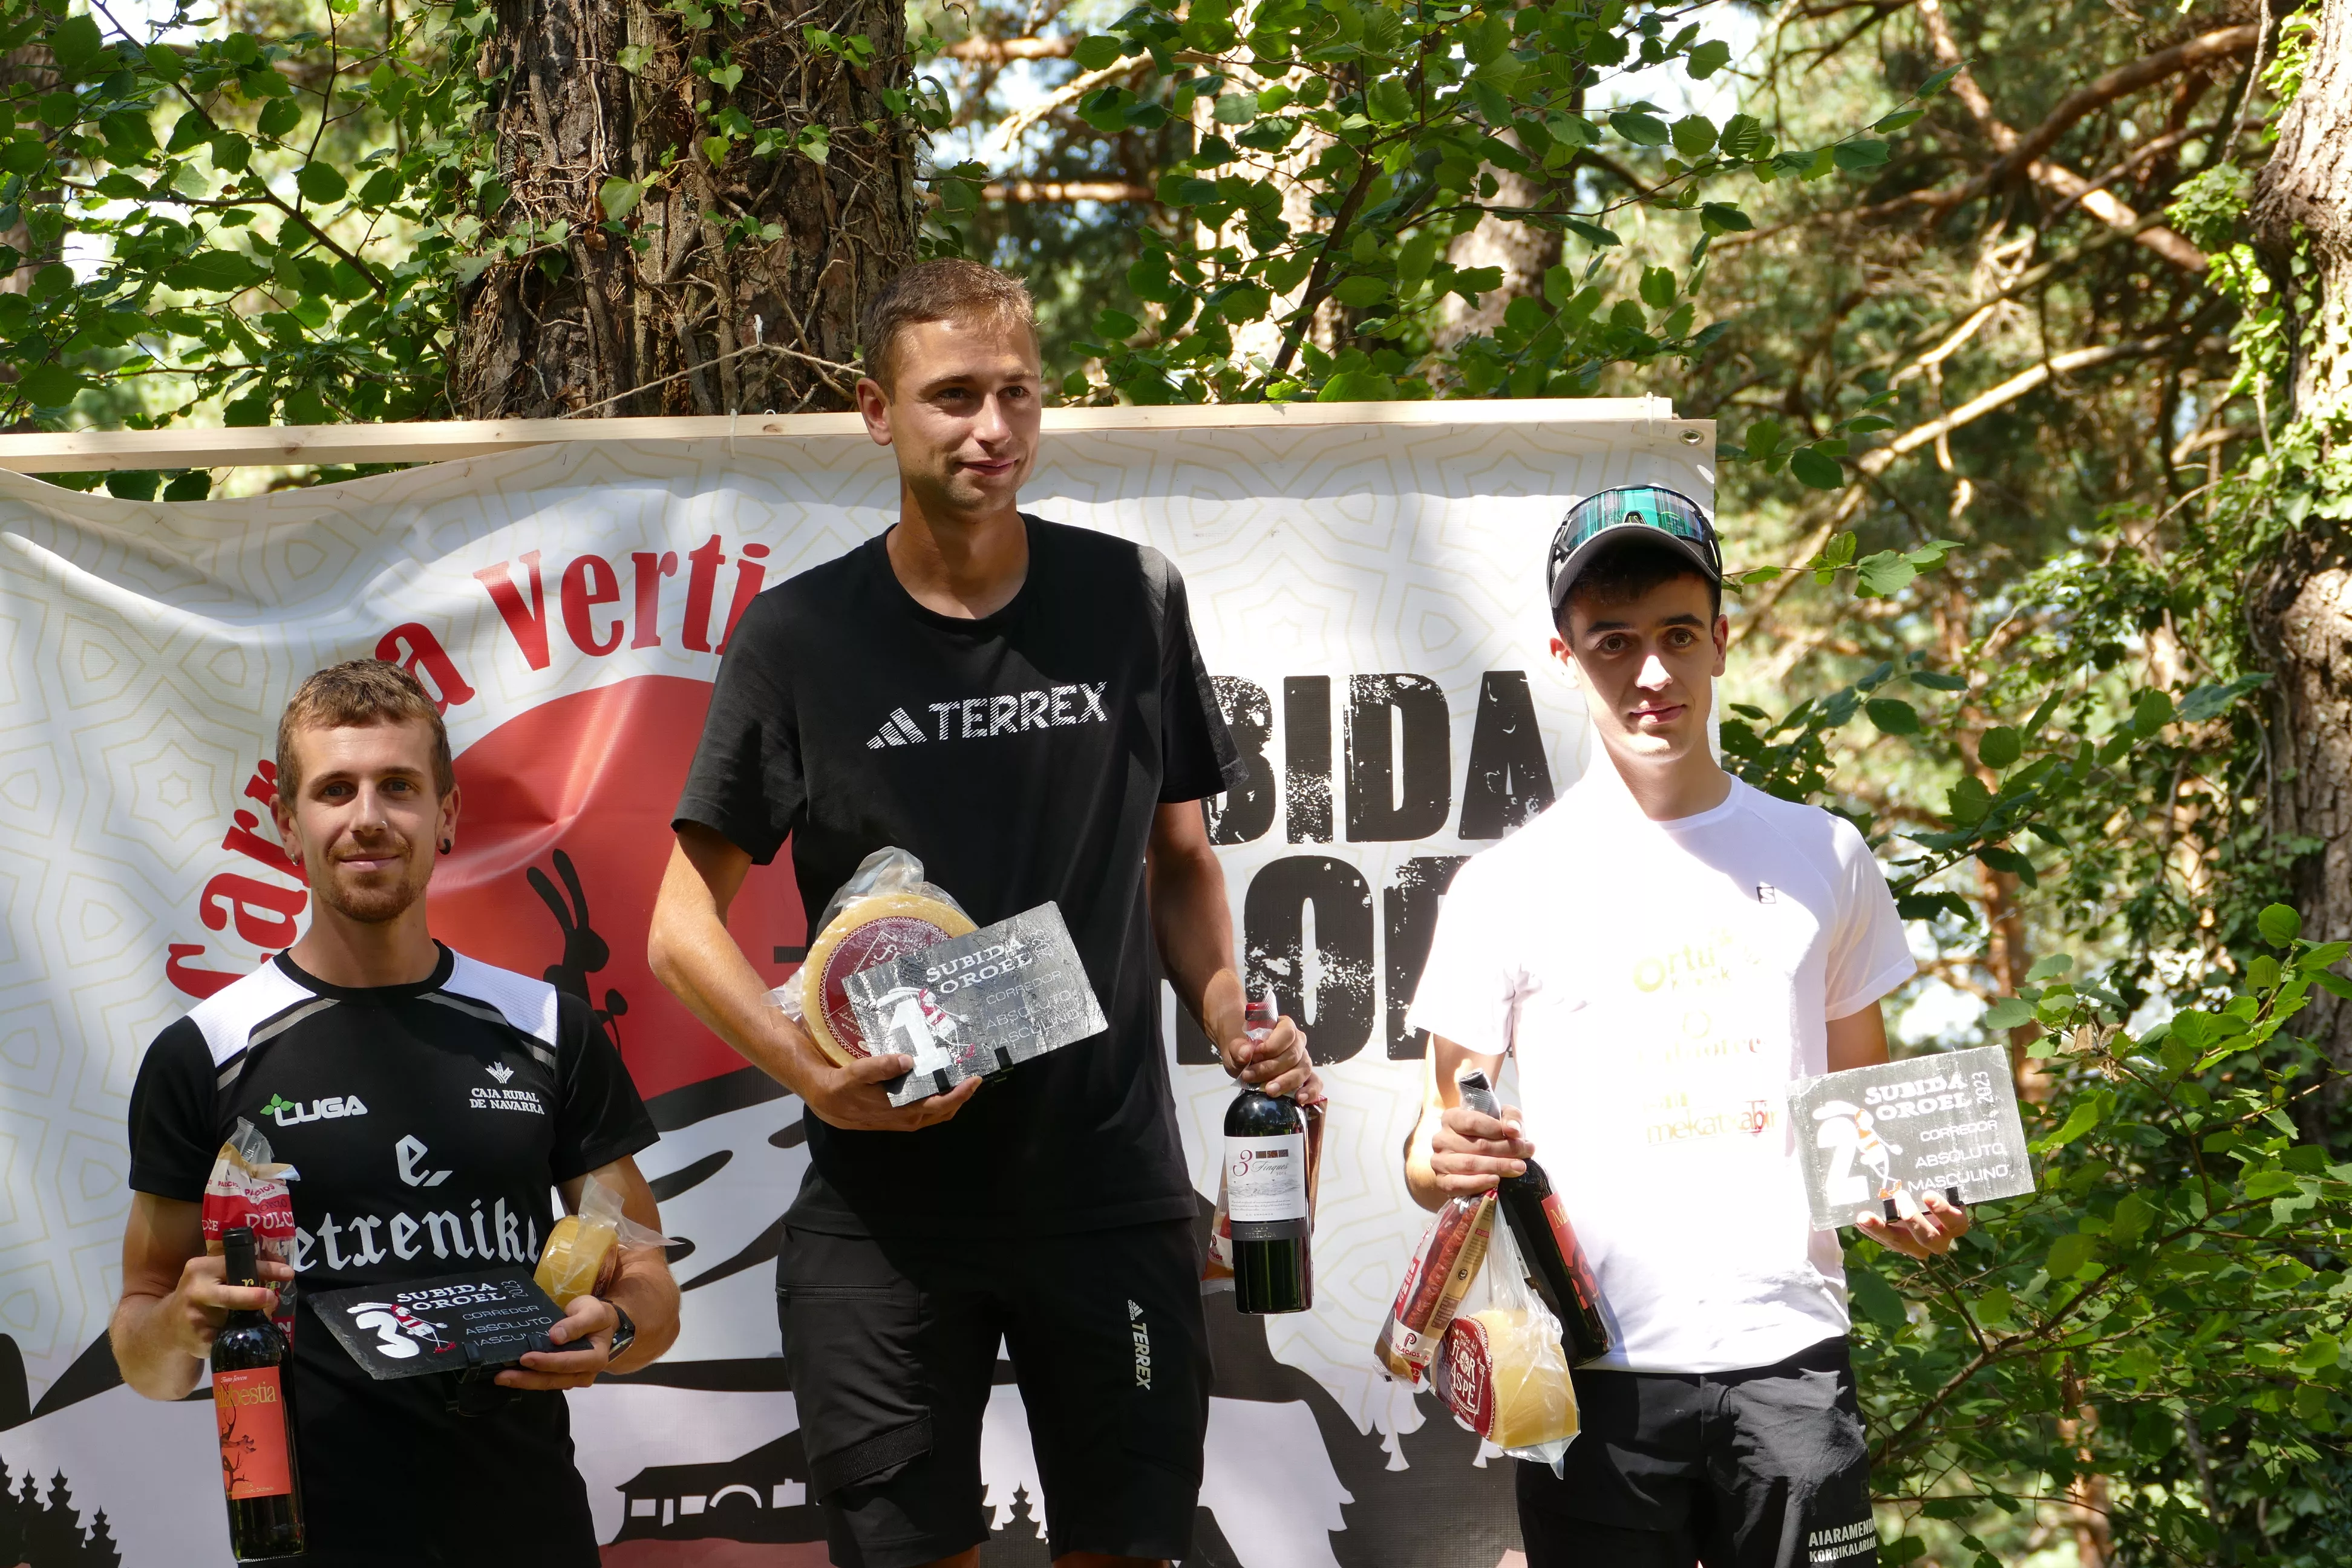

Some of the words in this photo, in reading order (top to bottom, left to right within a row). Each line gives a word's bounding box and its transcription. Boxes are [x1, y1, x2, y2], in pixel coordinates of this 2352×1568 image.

[472, 534, 771, 671] Verti
[929, 681, 1108, 741] TERREX
[926, 938, 1025, 983] SUBIDA
[940, 953, 1033, 994] OROEL
[986, 970, 1062, 1005] CORREDOR
[987, 990, 1071, 1030] ABSOLUTO
[981, 1009, 1080, 1053] MASCULINO
[471, 1088, 501, 1099] CAJA
[502, 1089, 540, 1103] RURAL
[1864, 1073, 1968, 1106] SUBIDA
[1971, 1071, 1994, 1105] 2023
[274, 1095, 368, 1127] LUGA
[469, 1099, 486, 1108] DE
[489, 1100, 545, 1115] NAVARRA
[1875, 1092, 1973, 1121] OROEL
[1919, 1119, 1998, 1142] CORREDOR
[1233, 1149, 1253, 1177] 3
[1915, 1143, 2007, 1169] ABSOLUTO
[1907, 1164, 2009, 1194] MASCULINO
[397, 1282, 498, 1302] SUBIDA
[412, 1293, 506, 1312] OROEL
[501, 1280, 529, 1299] 2023
[462, 1305, 540, 1321] CORREDOR
[466, 1317, 552, 1335] ABSOLUTO
[1131, 1322, 1151, 1391] TERREX
[1395, 1342, 1420, 1358] PALACIOS
[214, 1381, 278, 1408] alabestia
[1450, 1362, 1475, 1408] ASPE
